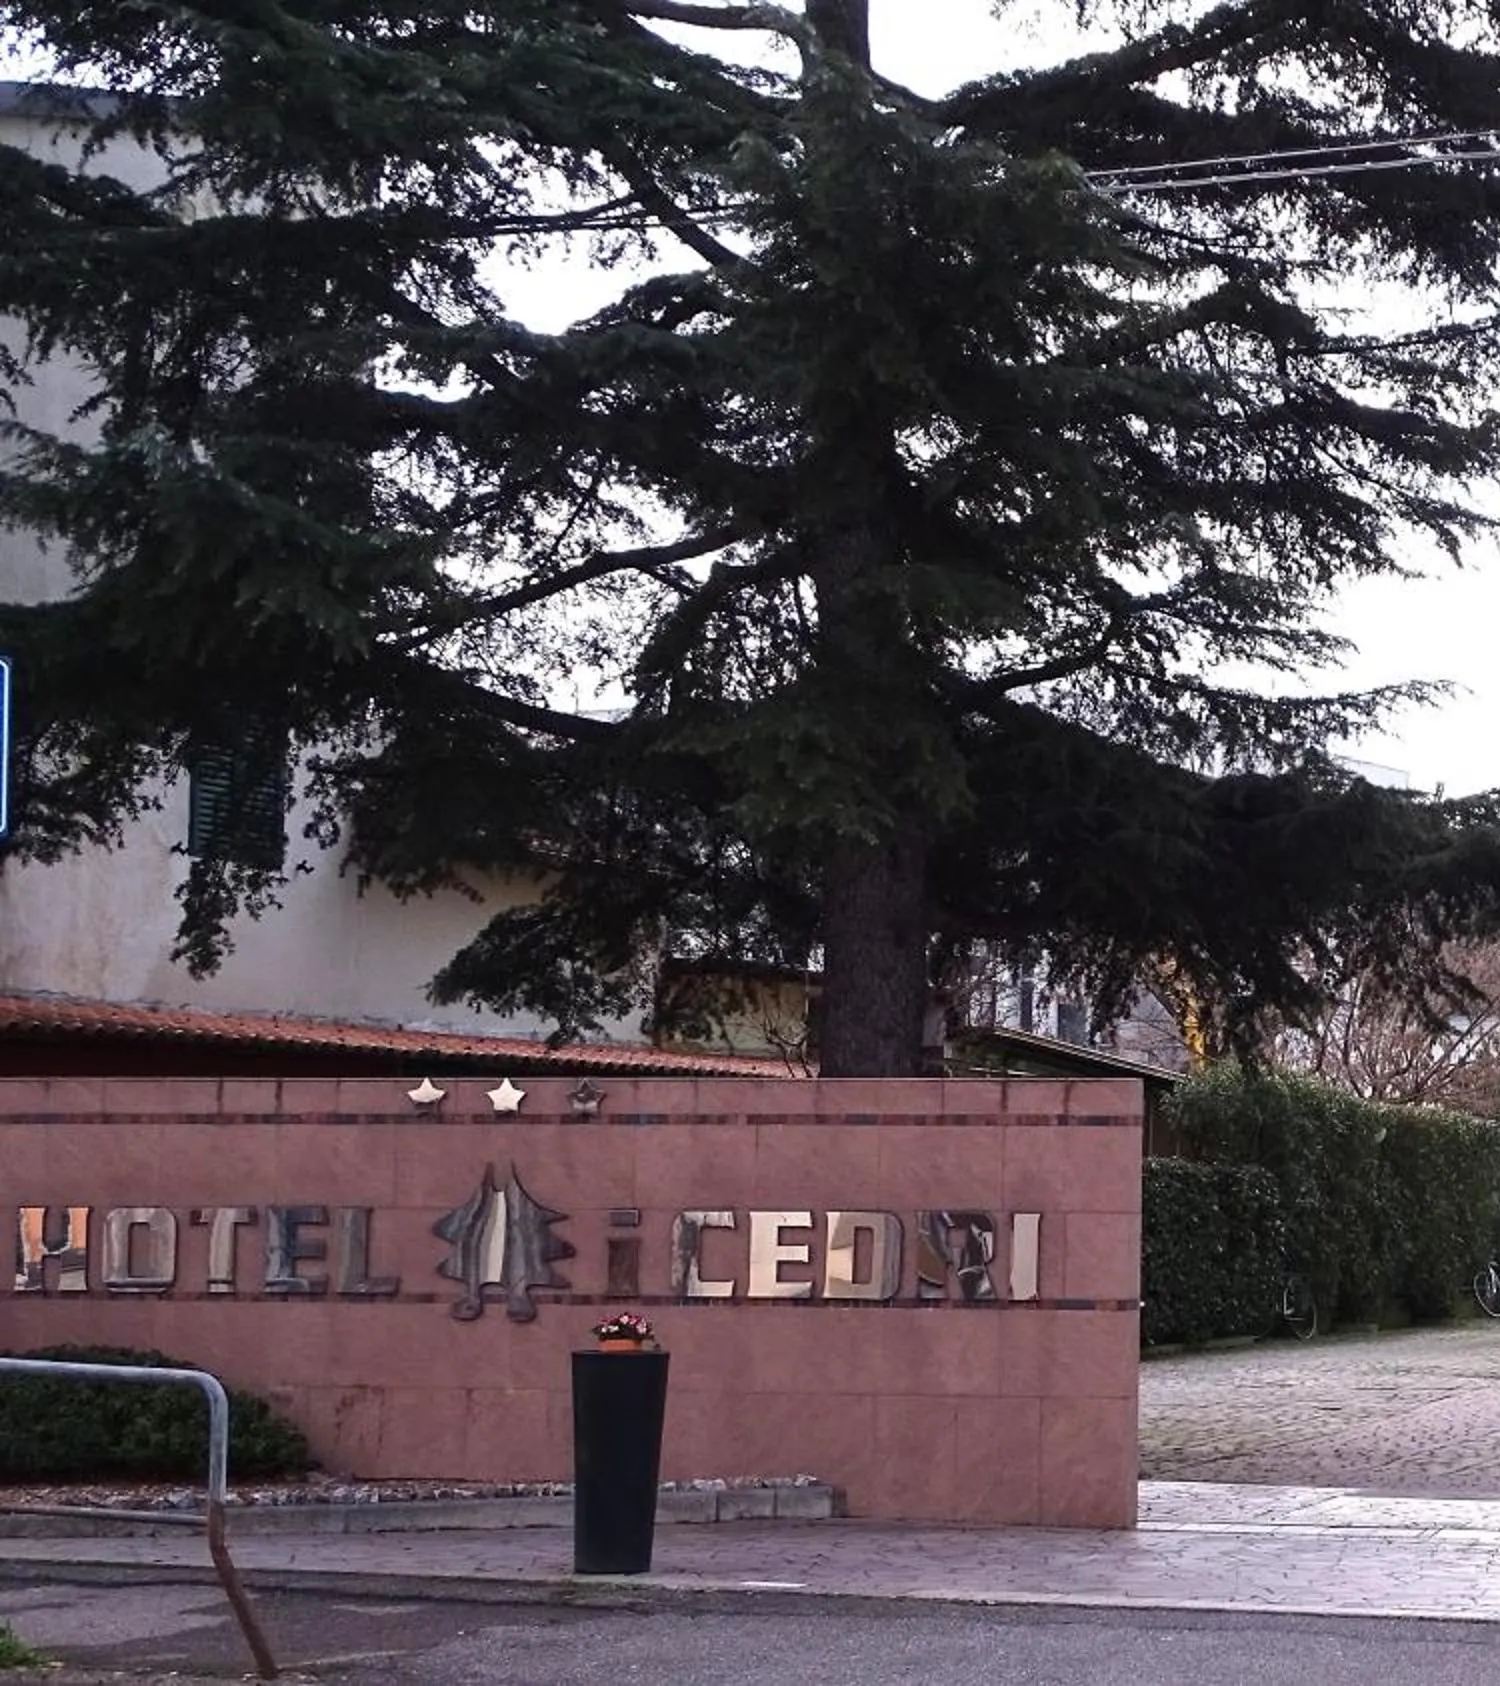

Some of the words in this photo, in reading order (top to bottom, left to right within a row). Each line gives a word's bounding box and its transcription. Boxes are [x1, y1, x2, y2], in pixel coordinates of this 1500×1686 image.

[14, 1206, 401, 1294] HOTEL
[608, 1208, 641, 1298] i
[671, 1210, 1042, 1300] CEDRI
